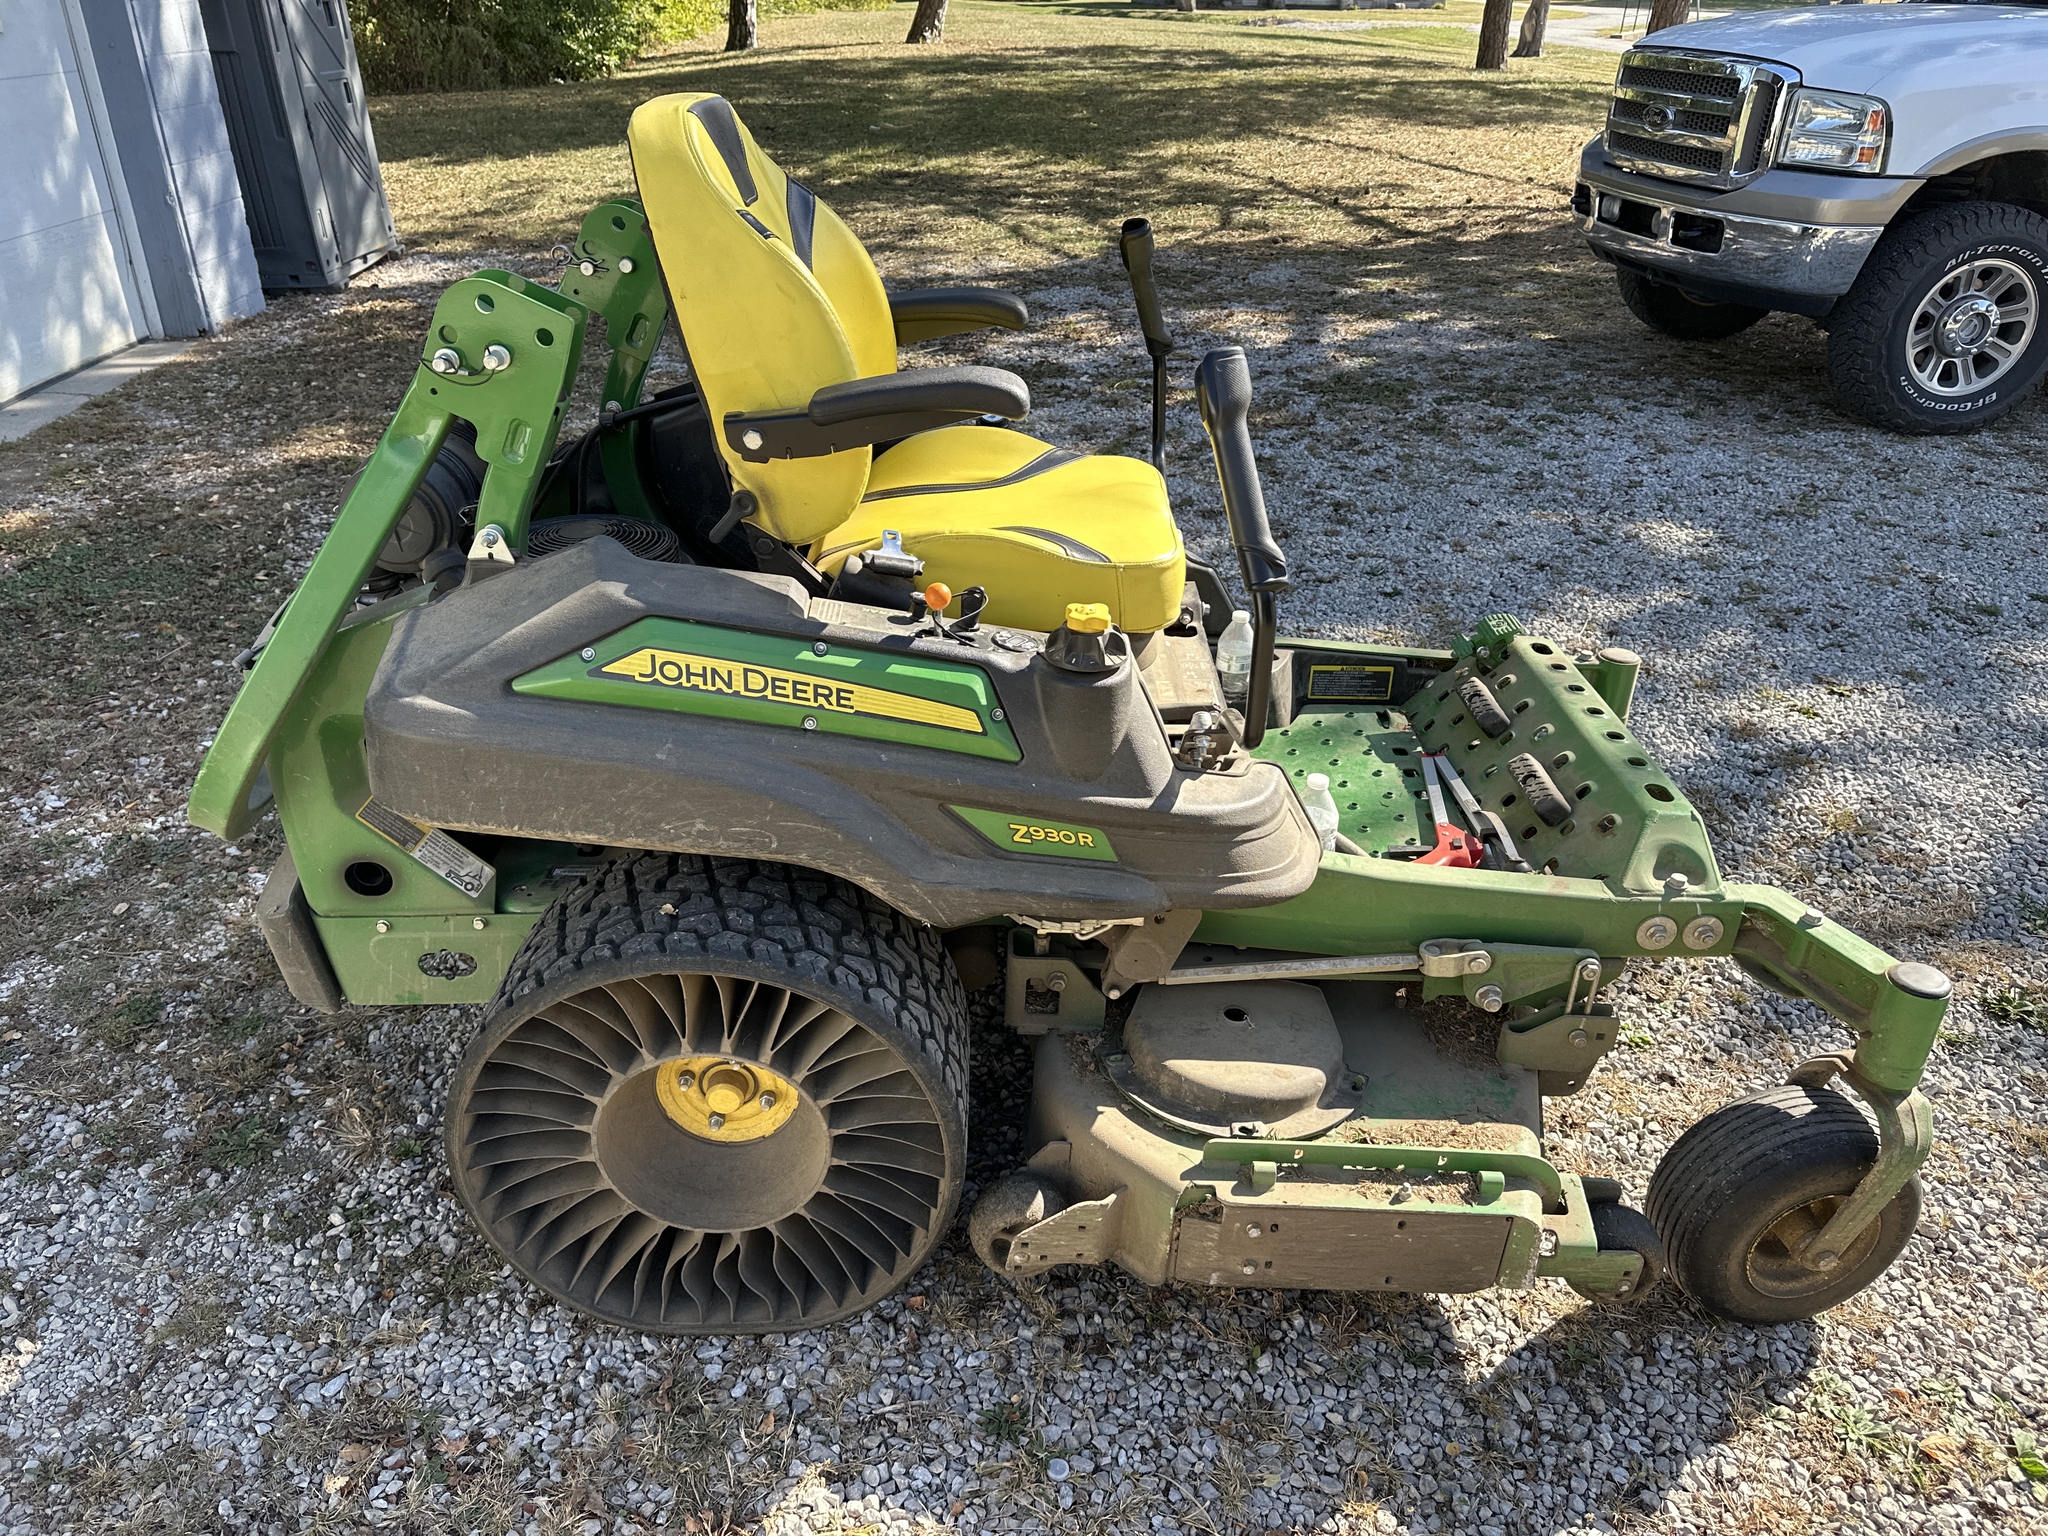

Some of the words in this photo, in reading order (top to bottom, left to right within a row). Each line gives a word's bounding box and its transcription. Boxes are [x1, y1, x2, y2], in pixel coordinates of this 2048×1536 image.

[1944, 244, 2044, 272] All-Terrain
[1900, 376, 1997, 412] BFGoodrich
[638, 654, 732, 690] JOHN
[743, 667, 855, 710] DEERE
[1008, 822, 1097, 848] Z930R
